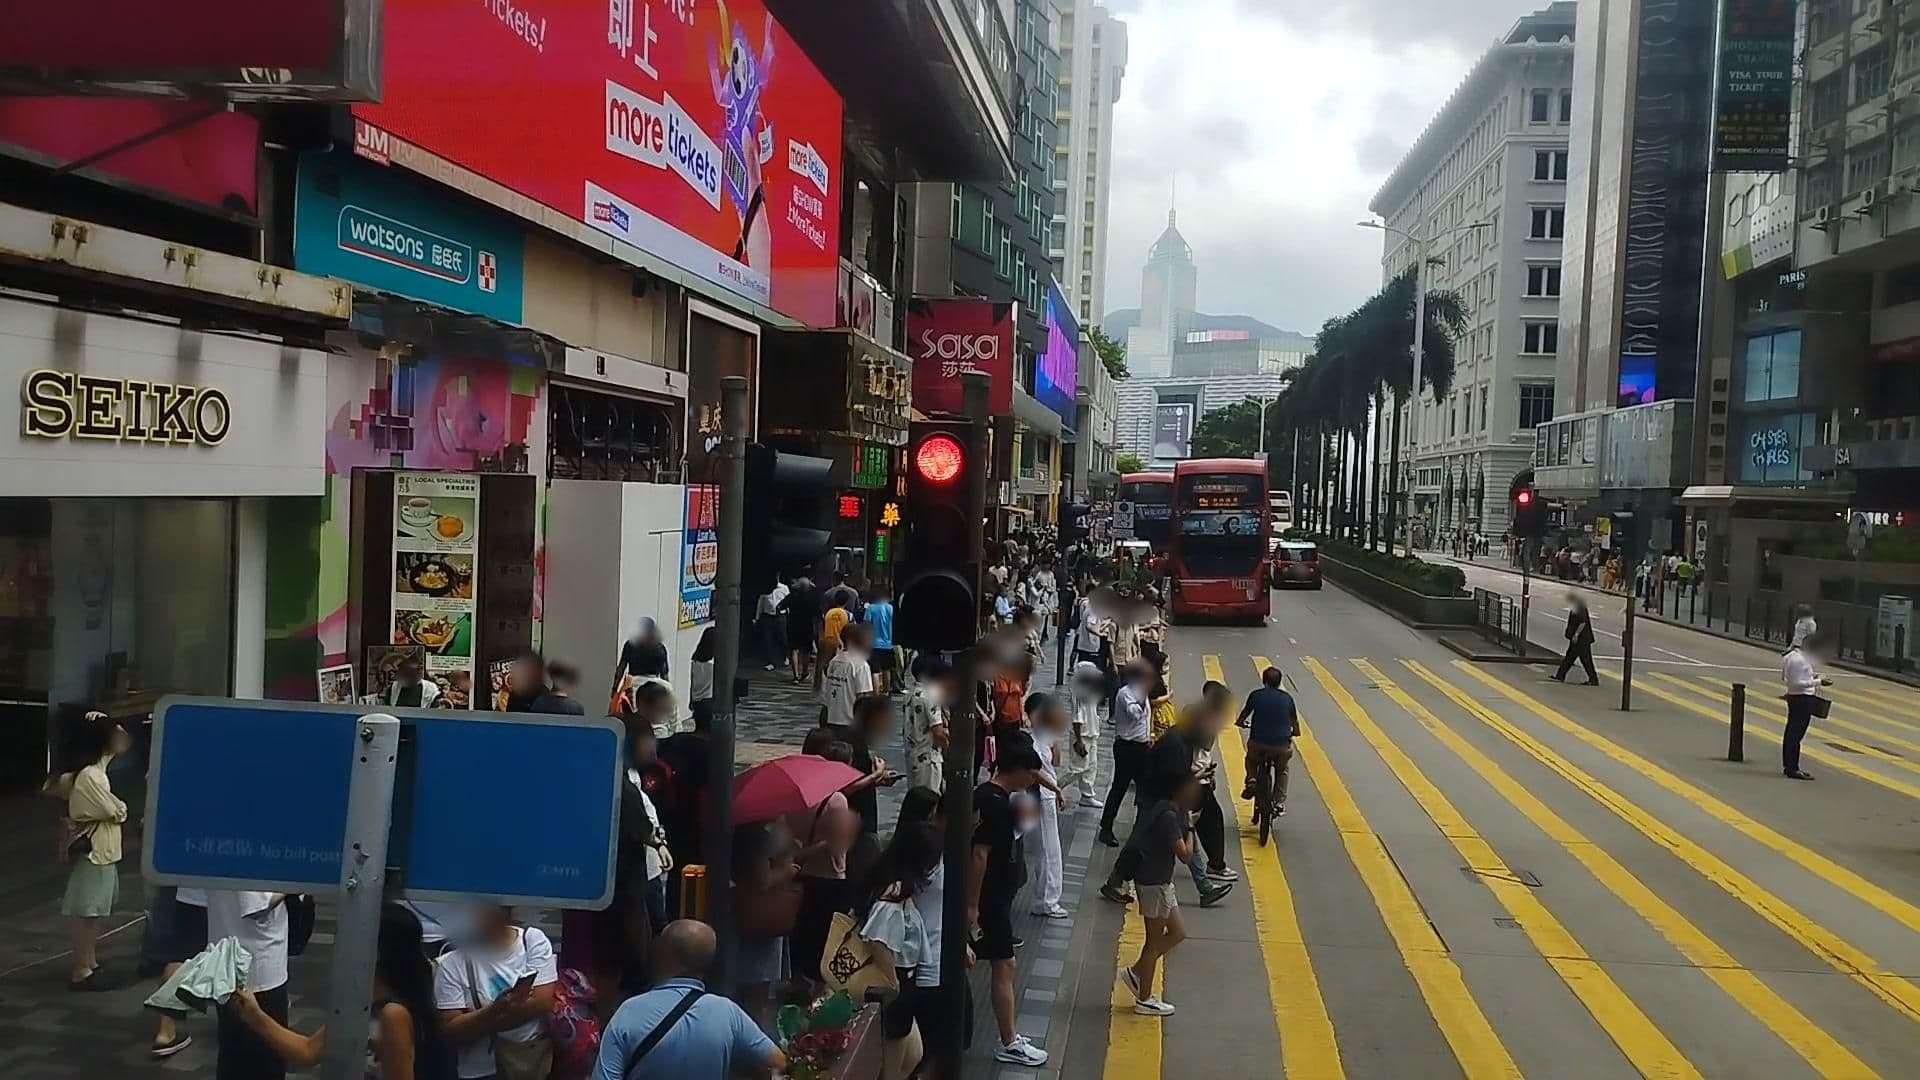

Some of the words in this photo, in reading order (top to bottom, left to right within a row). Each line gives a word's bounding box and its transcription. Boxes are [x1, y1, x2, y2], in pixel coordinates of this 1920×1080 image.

[1727, 82, 1765, 92] TICKET
[1728, 70, 1752, 80] VISA
[1756, 70, 1785, 80] TOUR
[357, 124, 389, 155] JM
[610, 97, 663, 154] more
[667, 112, 718, 194] tickets
[350, 217, 424, 261] watsons
[1779, 270, 1806, 285] PARIS
[25, 368, 232, 447] SEIKO
[260, 843, 281, 858] No
[285, 842, 306, 859] bill
